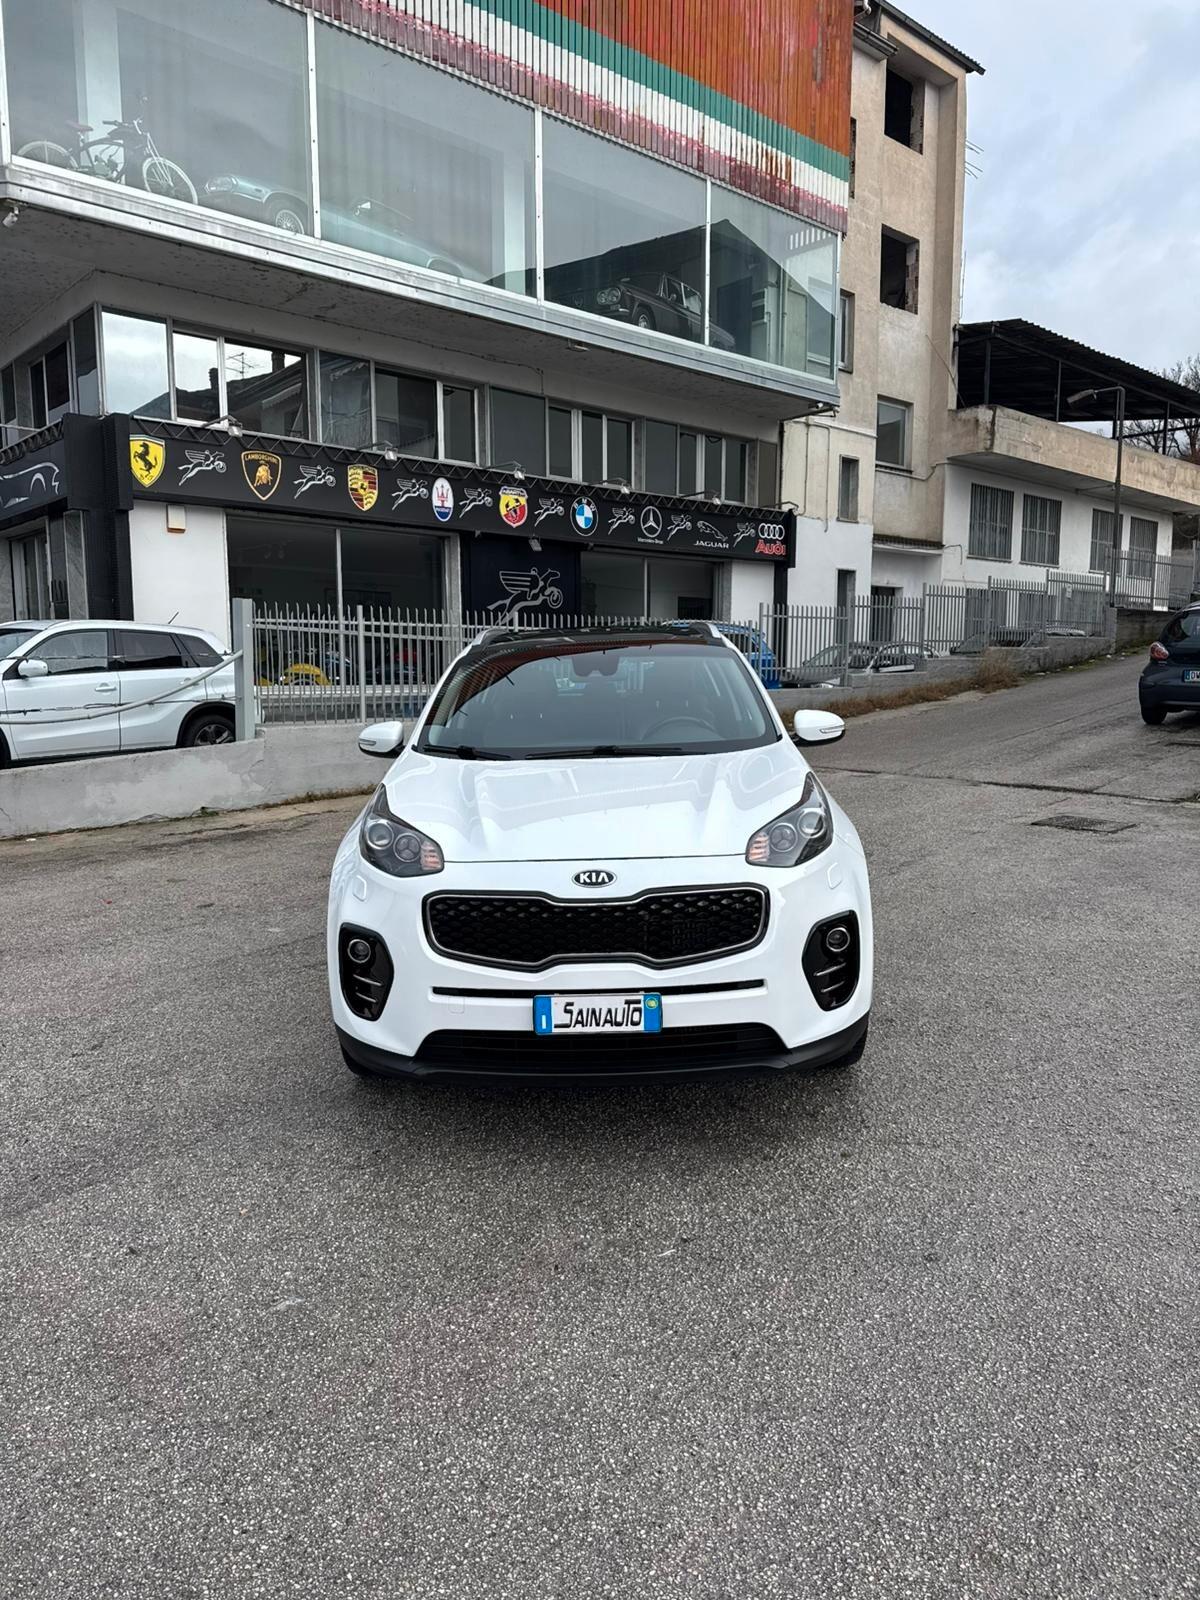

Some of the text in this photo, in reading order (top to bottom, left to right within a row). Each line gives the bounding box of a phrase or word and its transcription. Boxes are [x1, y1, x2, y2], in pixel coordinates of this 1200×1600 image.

[244, 453, 278, 464] LAMBORGHINI
[573, 498, 597, 511] BMW
[693, 540, 730, 549] JAGUAR
[580, 872, 609, 883] KIA
